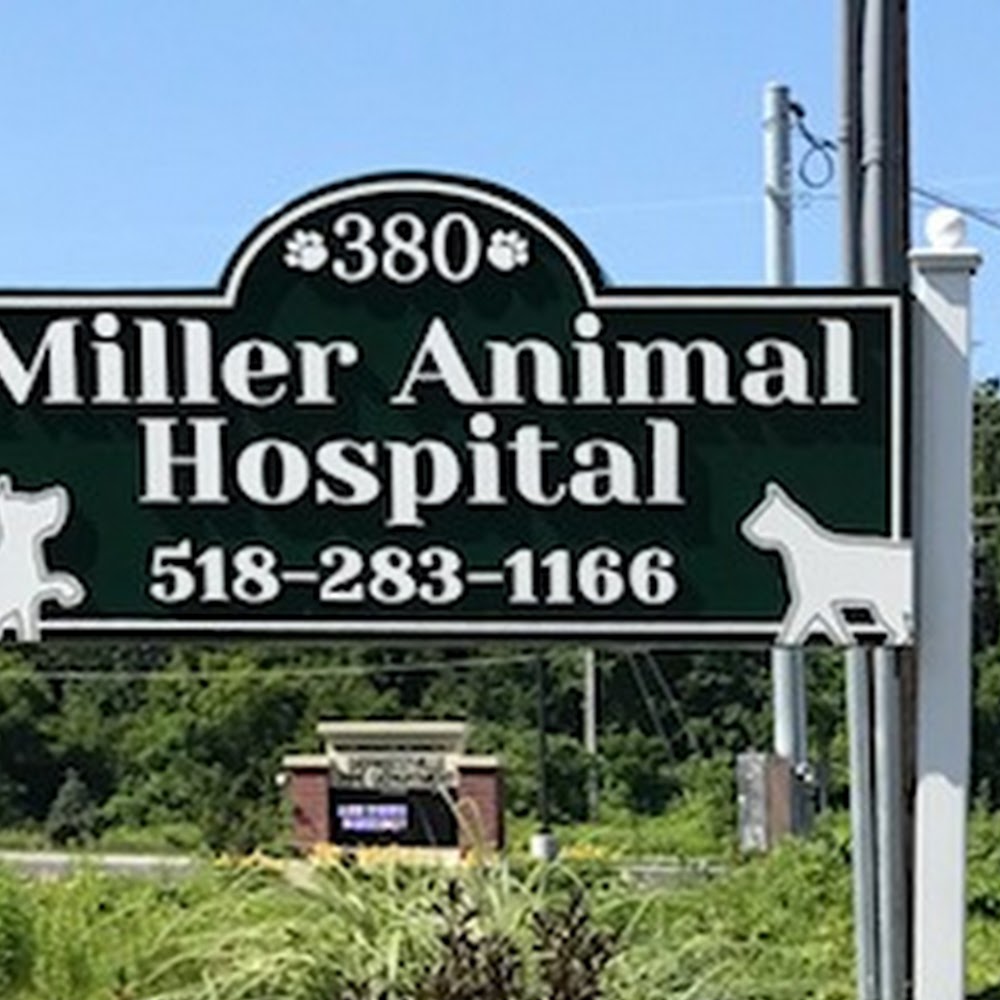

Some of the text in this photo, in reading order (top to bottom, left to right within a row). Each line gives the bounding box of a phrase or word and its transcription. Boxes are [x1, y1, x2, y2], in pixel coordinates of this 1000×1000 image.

[331, 212, 482, 284] 380
[0, 311, 859, 406] Miller Animal
[137, 411, 685, 527] Hospital
[149, 538, 677, 605] 518-283-1166
